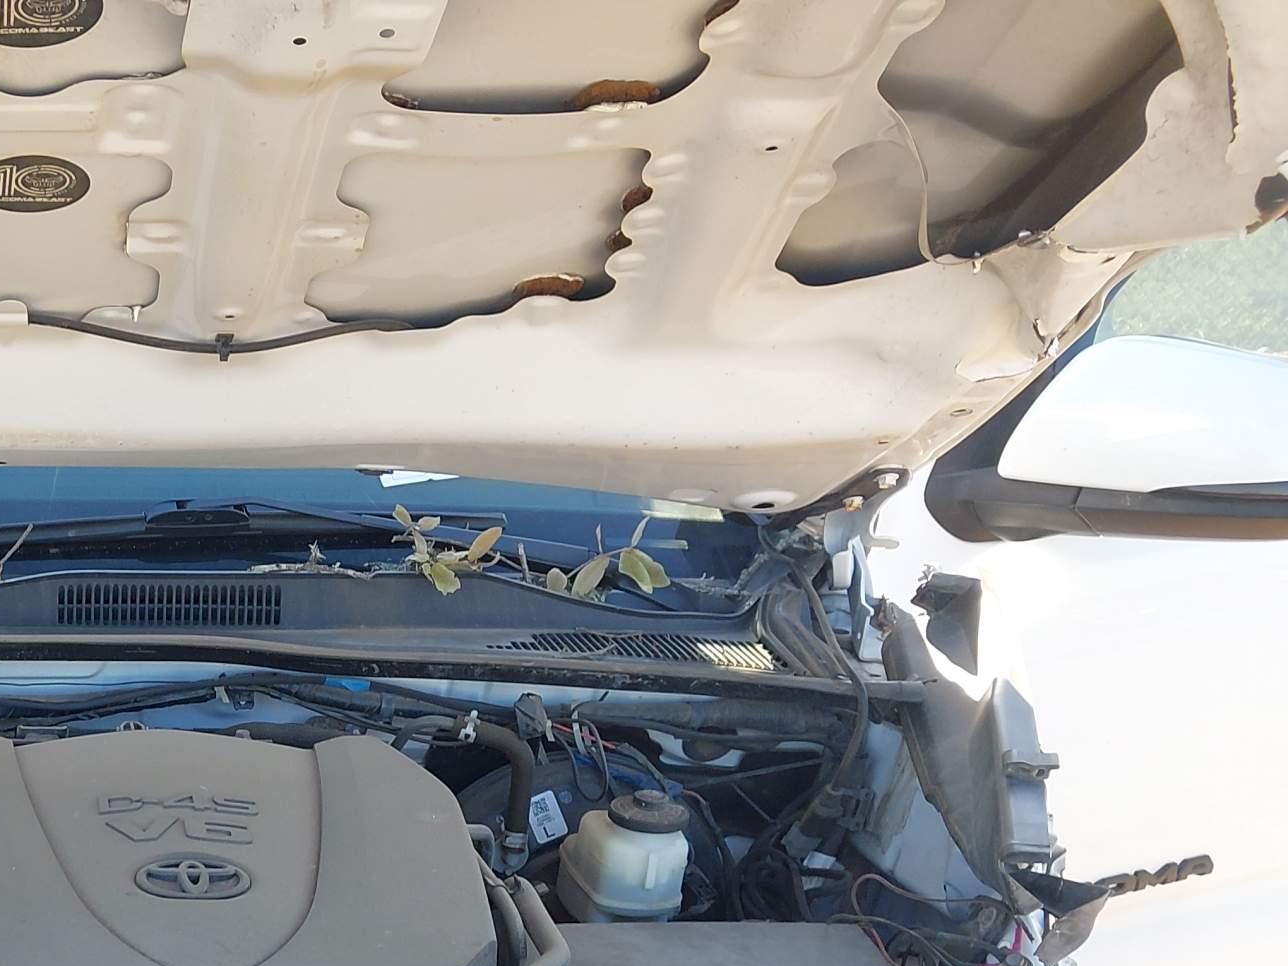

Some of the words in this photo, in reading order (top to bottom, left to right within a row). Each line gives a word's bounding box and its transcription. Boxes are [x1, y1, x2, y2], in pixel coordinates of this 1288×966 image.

[97, 795, 259, 816] D-4S
[104, 816, 253, 845] V6
[543, 826, 556, 838] L
